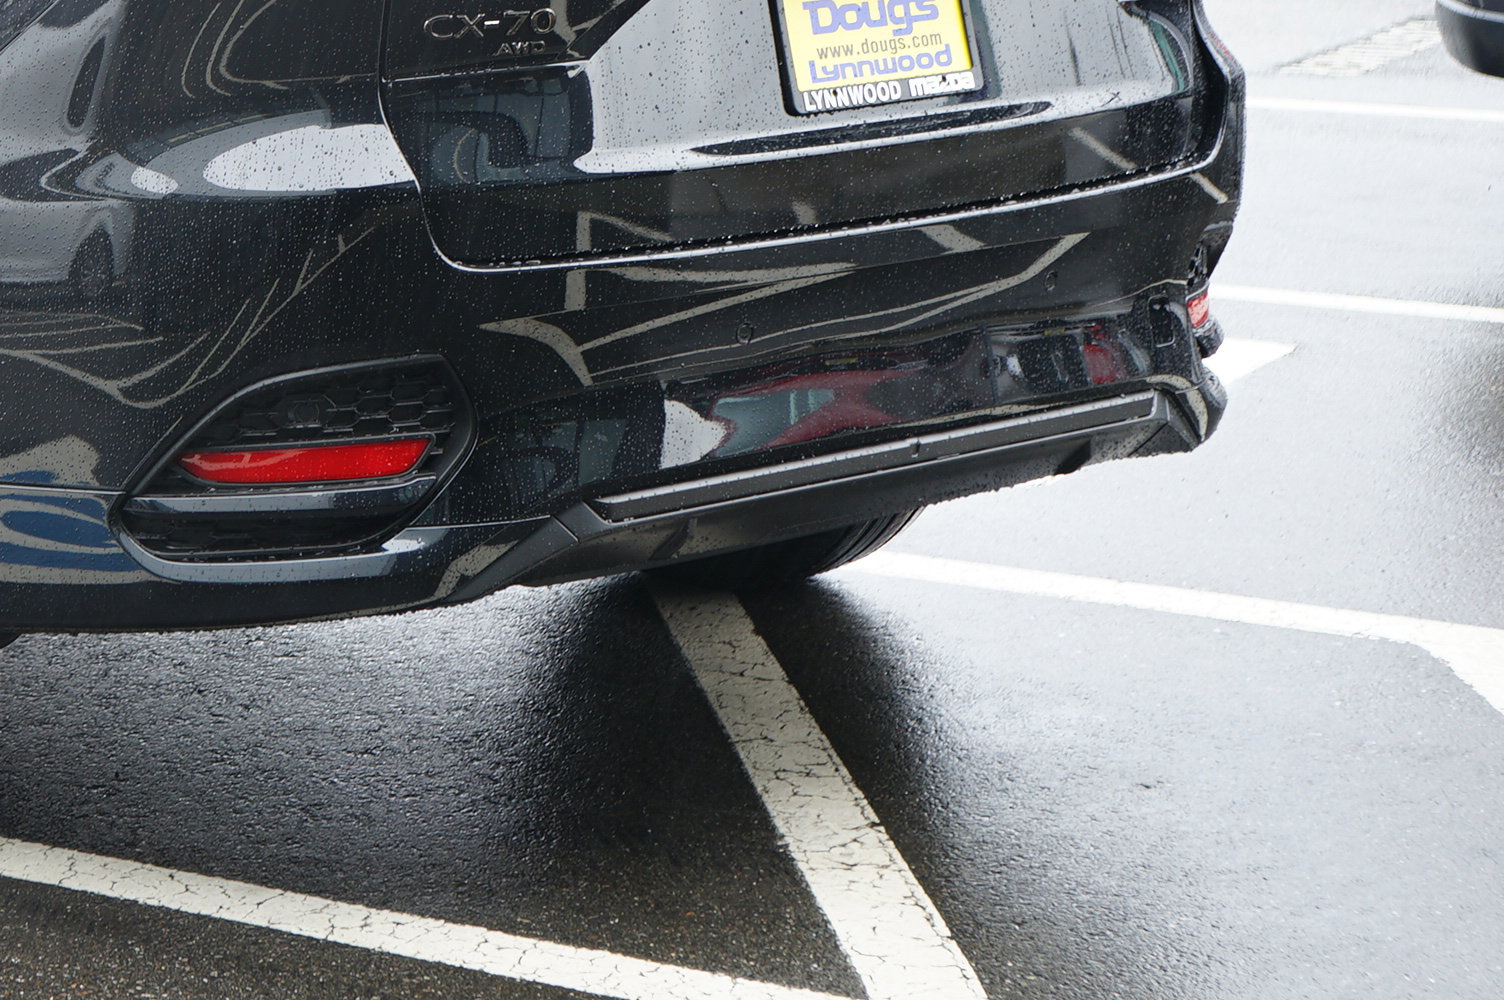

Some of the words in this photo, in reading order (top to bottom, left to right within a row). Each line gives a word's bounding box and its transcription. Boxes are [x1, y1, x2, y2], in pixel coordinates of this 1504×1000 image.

[423, 7, 557, 40] CX-70
[495, 40, 546, 57] AWD
[816, 31, 943, 60] www.dougs.com
[808, 43, 953, 84] Lynnwood
[802, 80, 902, 112] LYNNWOOD
